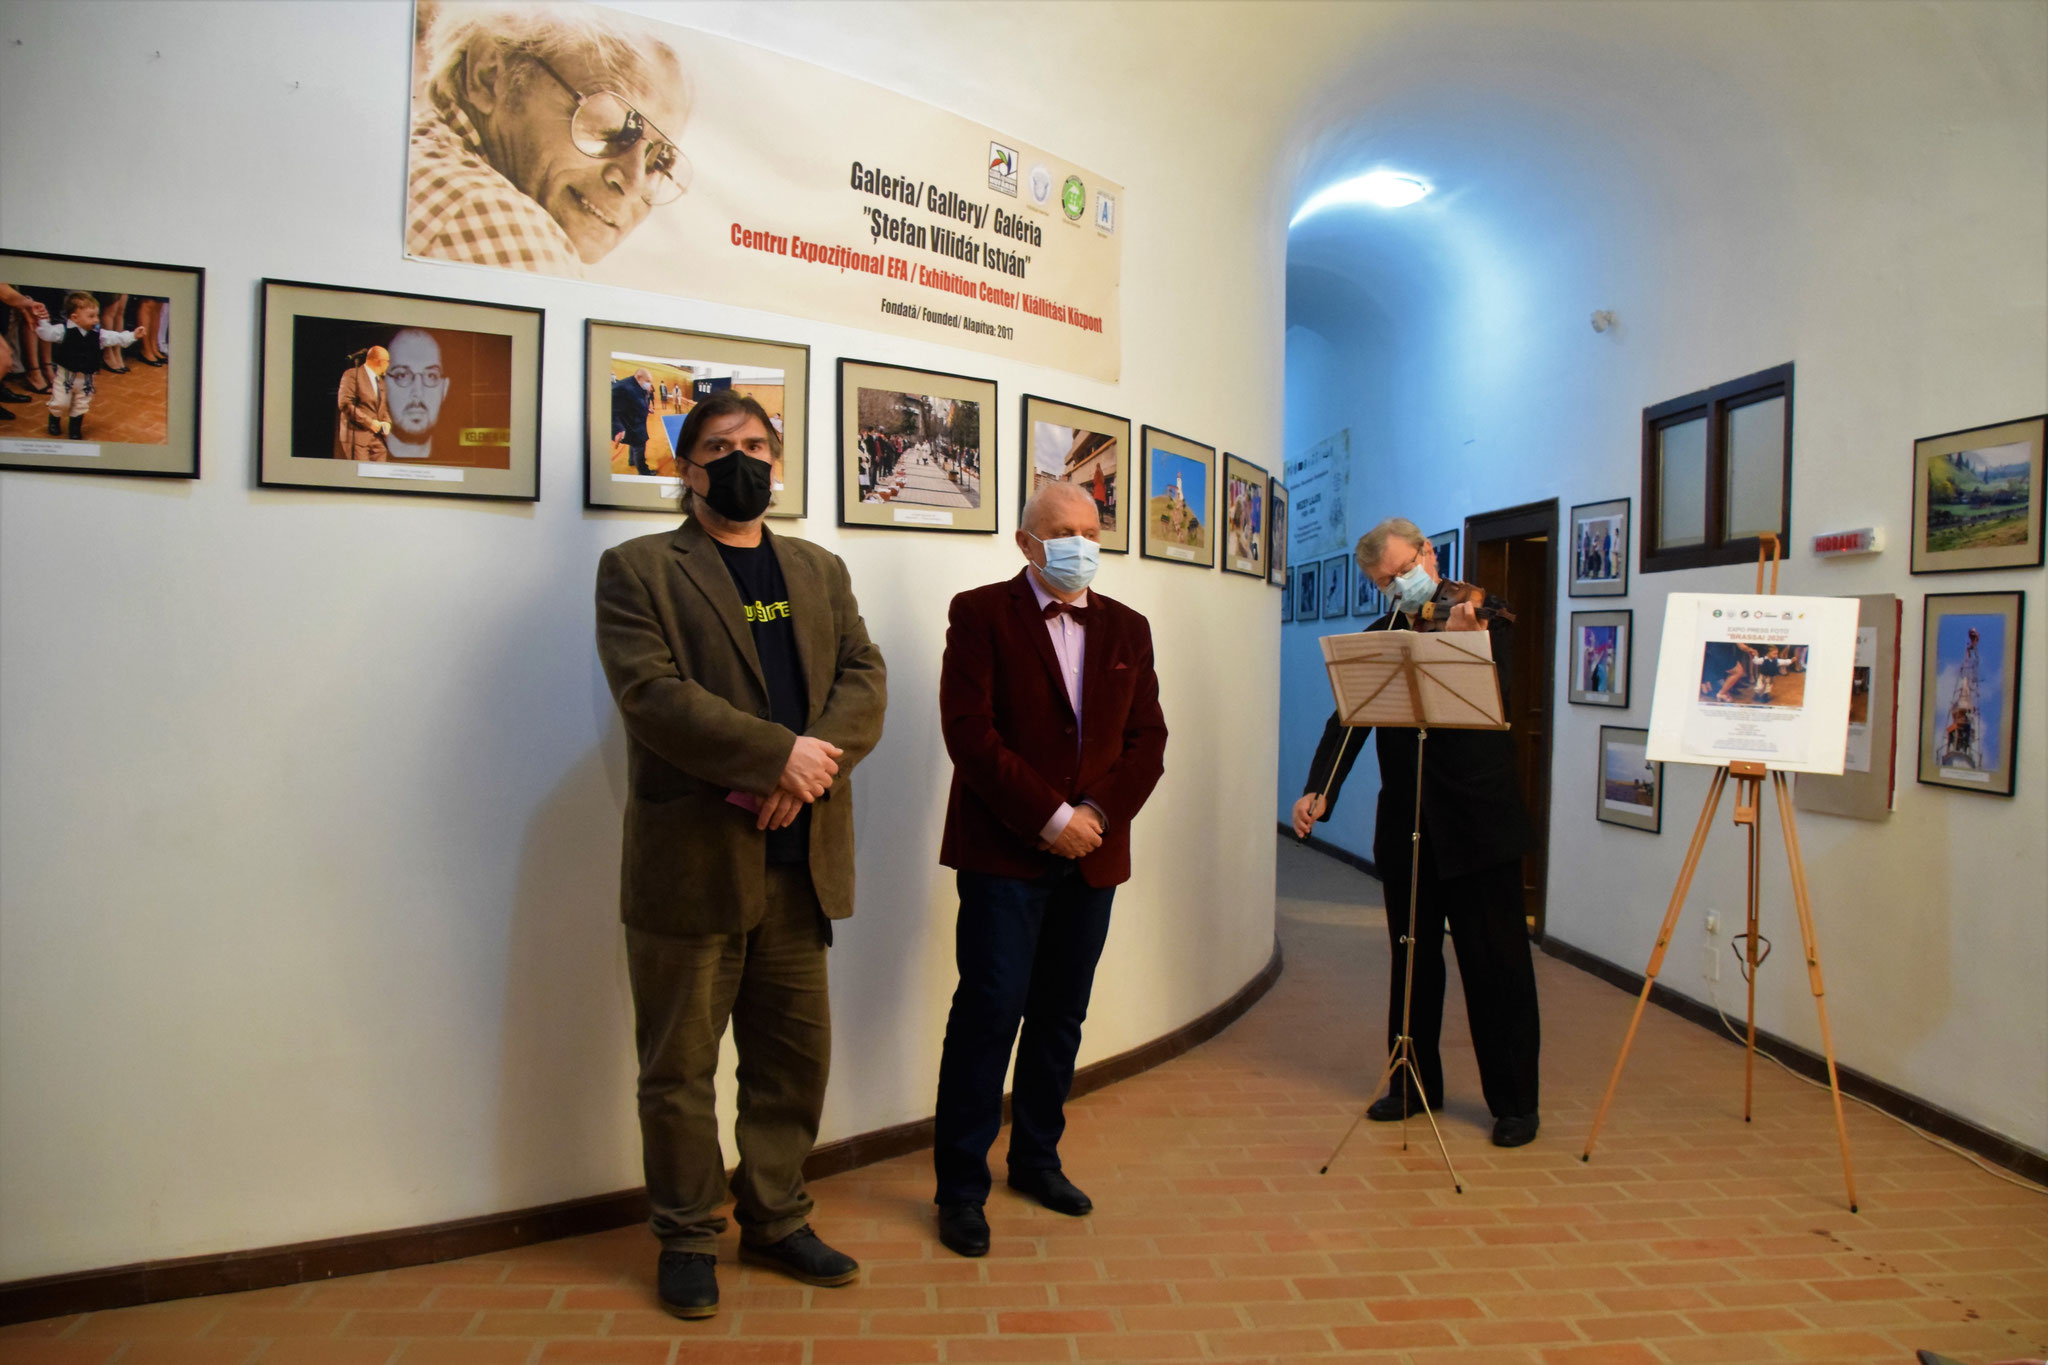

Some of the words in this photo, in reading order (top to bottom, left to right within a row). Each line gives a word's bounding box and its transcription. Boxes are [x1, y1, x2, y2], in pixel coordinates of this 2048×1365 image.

[850, 161, 923, 207] Galeria/
[927, 184, 989, 229] Gallery/
[994, 207, 1041, 247] Galéria
[930, 225, 980, 265] Vilidár
[731, 223, 787, 256] Centru
[791, 235, 884, 274] Expozițional
[887, 256, 908, 282] EFA
[919, 265, 977, 299] Exhibition
[979, 281, 1020, 310] Center/
[1022, 293, 1066, 323] Kiállítási
[1067, 307, 1103, 334] Központ
[922, 307, 962, 329] Founded/
[997, 325, 1014, 341] 2017
